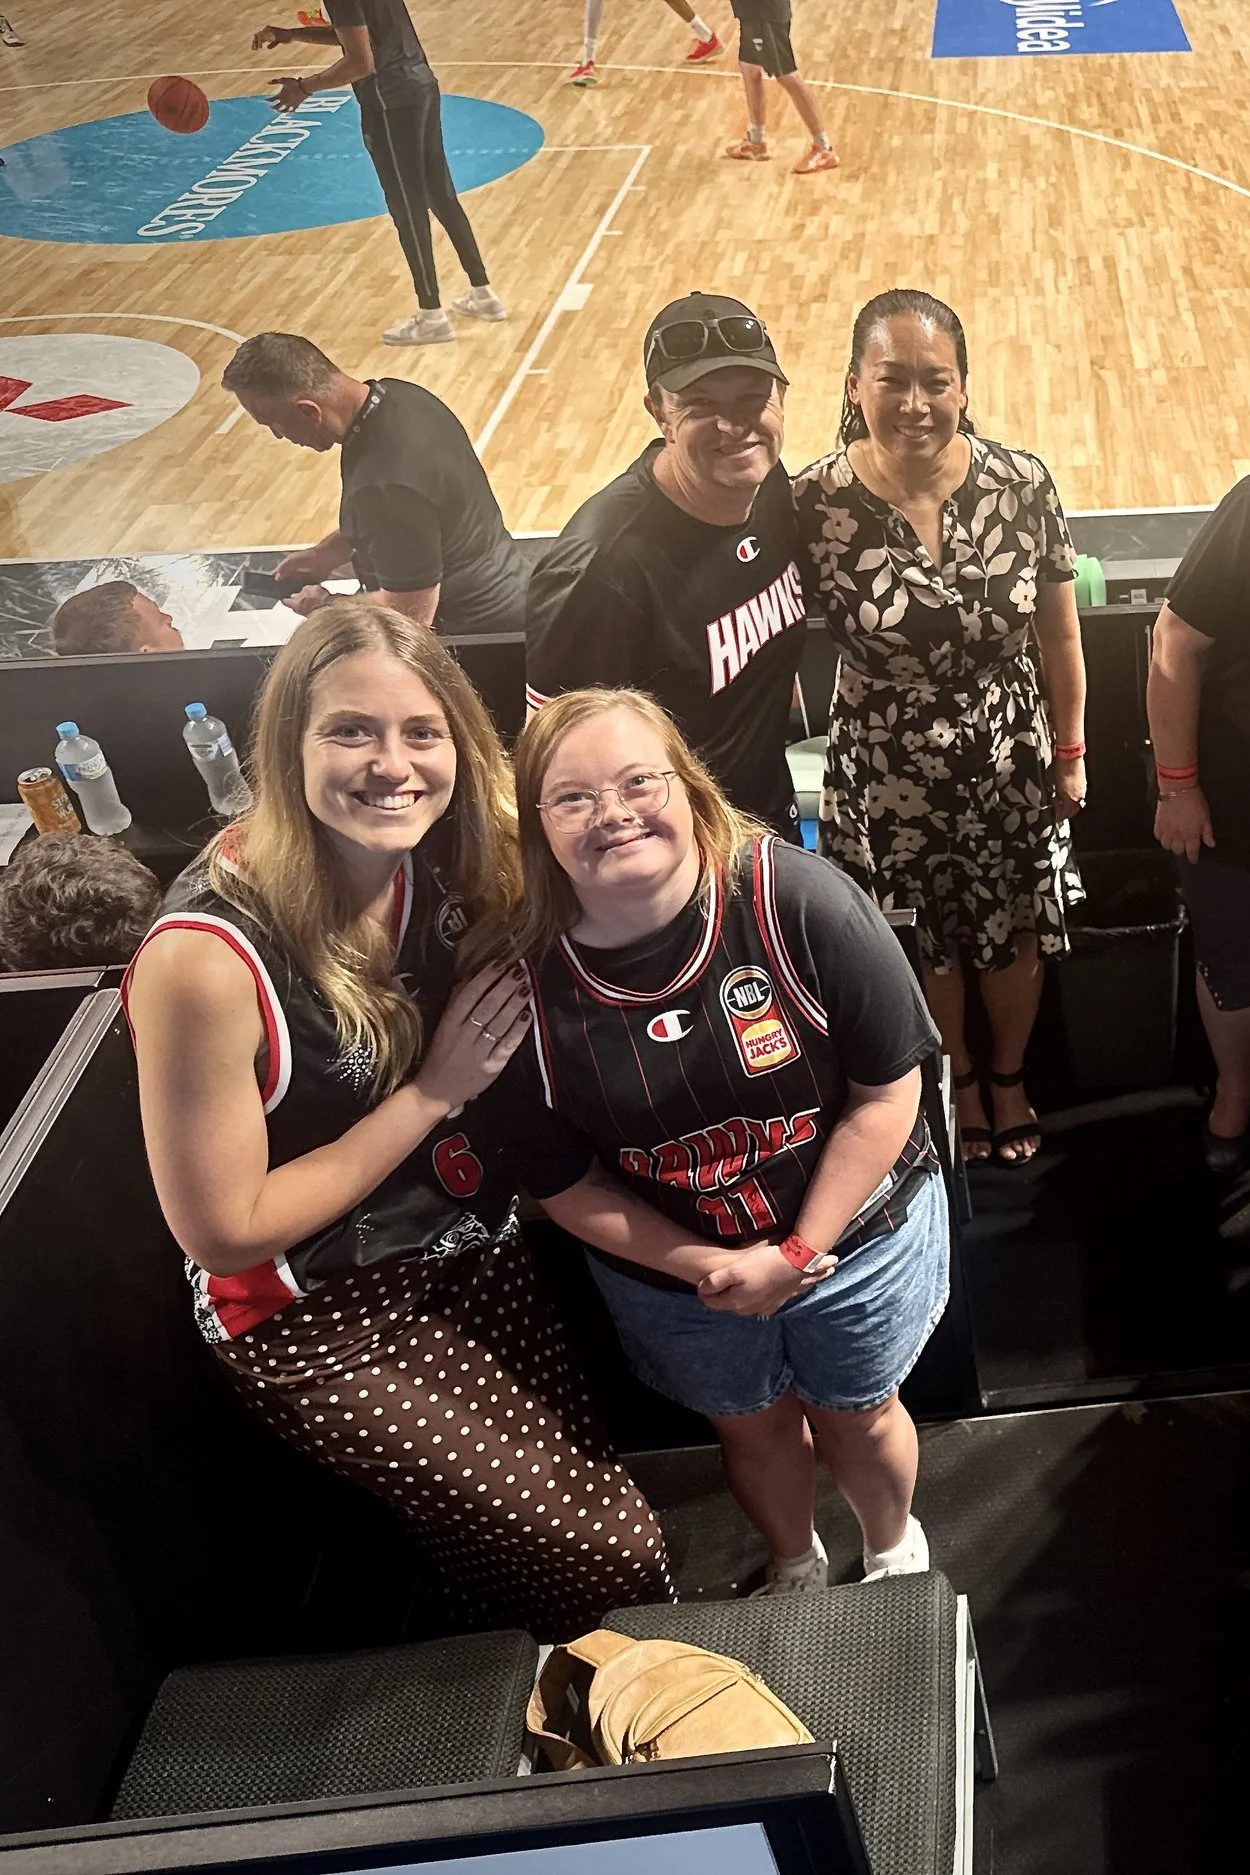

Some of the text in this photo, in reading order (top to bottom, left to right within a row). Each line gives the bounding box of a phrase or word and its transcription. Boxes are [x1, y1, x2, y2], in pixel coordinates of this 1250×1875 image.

[136, 95, 352, 237] BLACKMORES
[706, 561, 806, 697] HAWKS
[733, 981, 766, 1009] NBL
[745, 1028, 783, 1049] HUNGRY
[749, 1037, 788, 1060] JACK'S
[432, 1132, 484, 1198] 6
